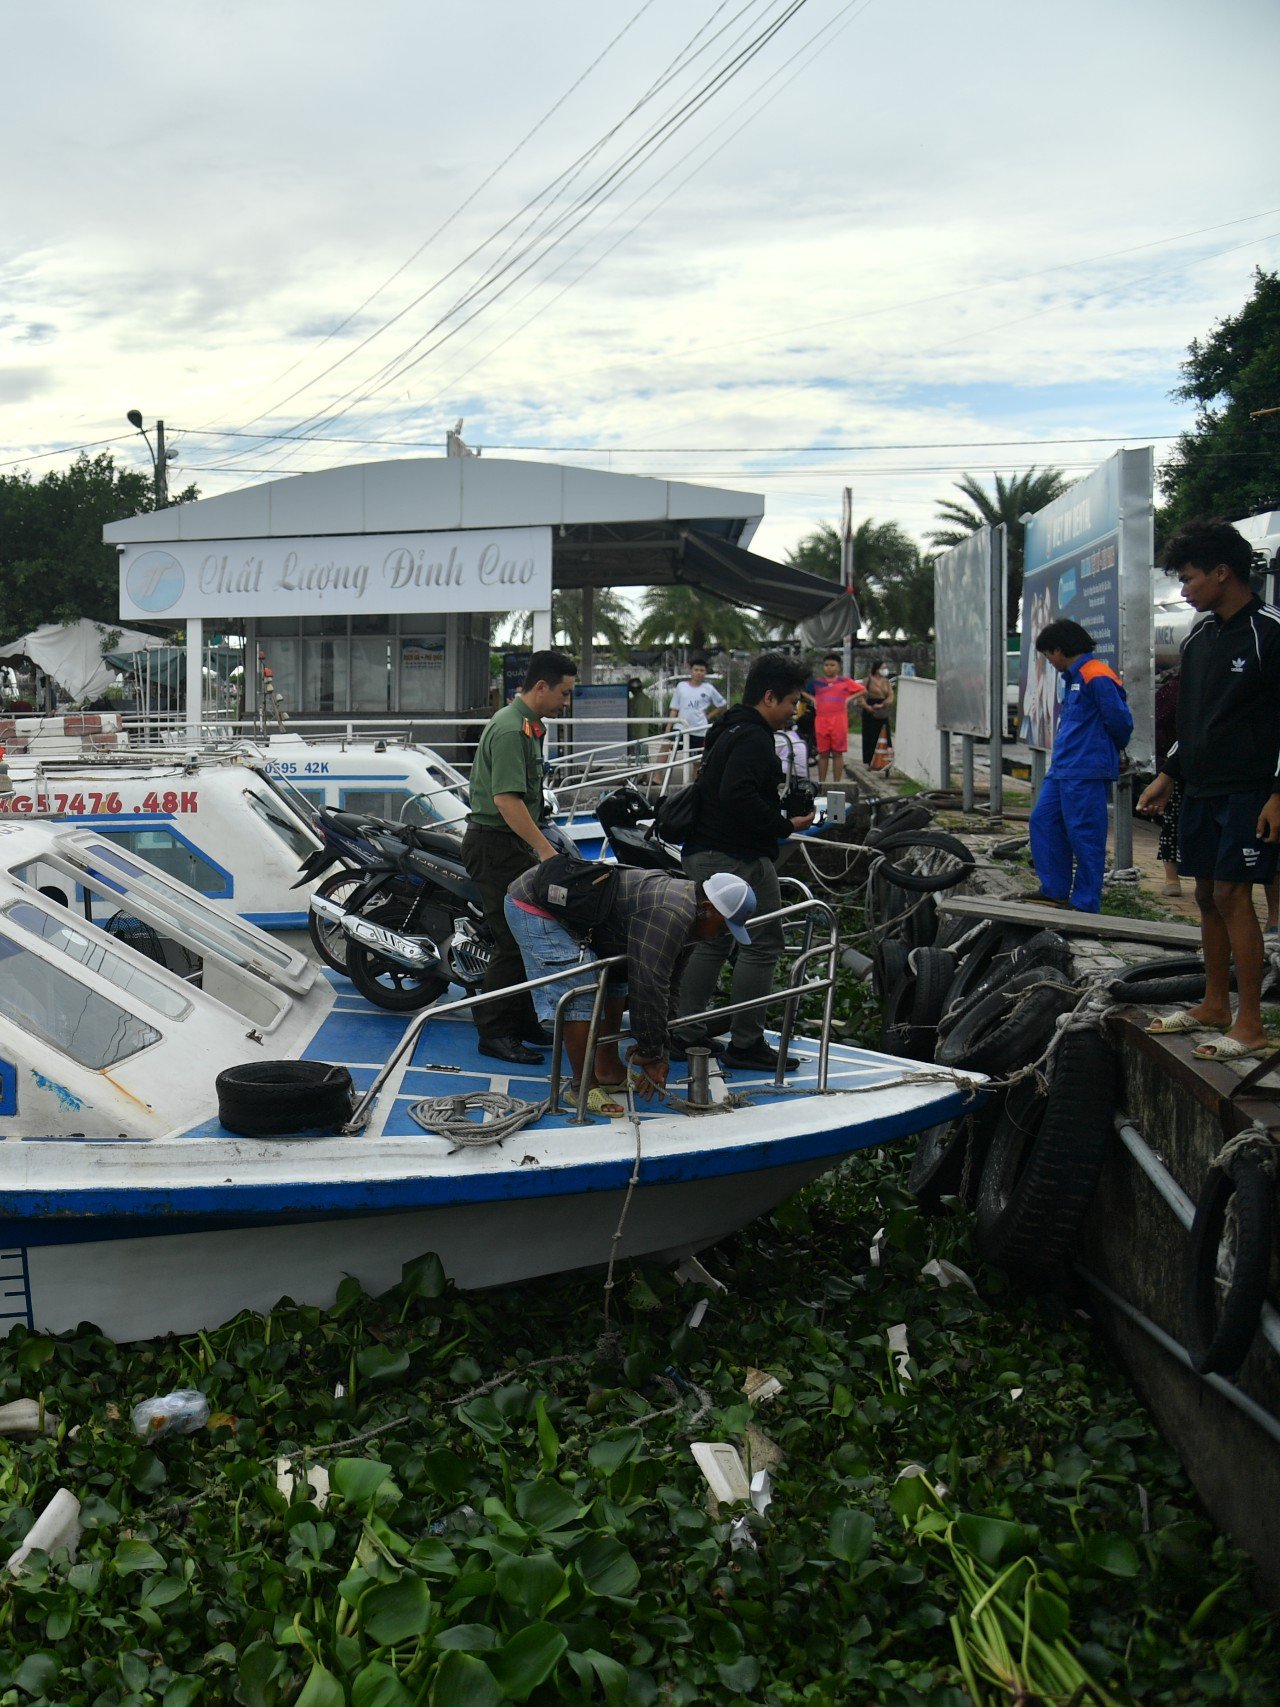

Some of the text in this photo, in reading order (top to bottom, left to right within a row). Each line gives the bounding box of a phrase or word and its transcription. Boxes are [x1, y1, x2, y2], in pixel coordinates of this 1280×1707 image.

[199, 543, 538, 599] Chất Lượng Đỉnh Cao
[305, 762, 329, 773] 42K
